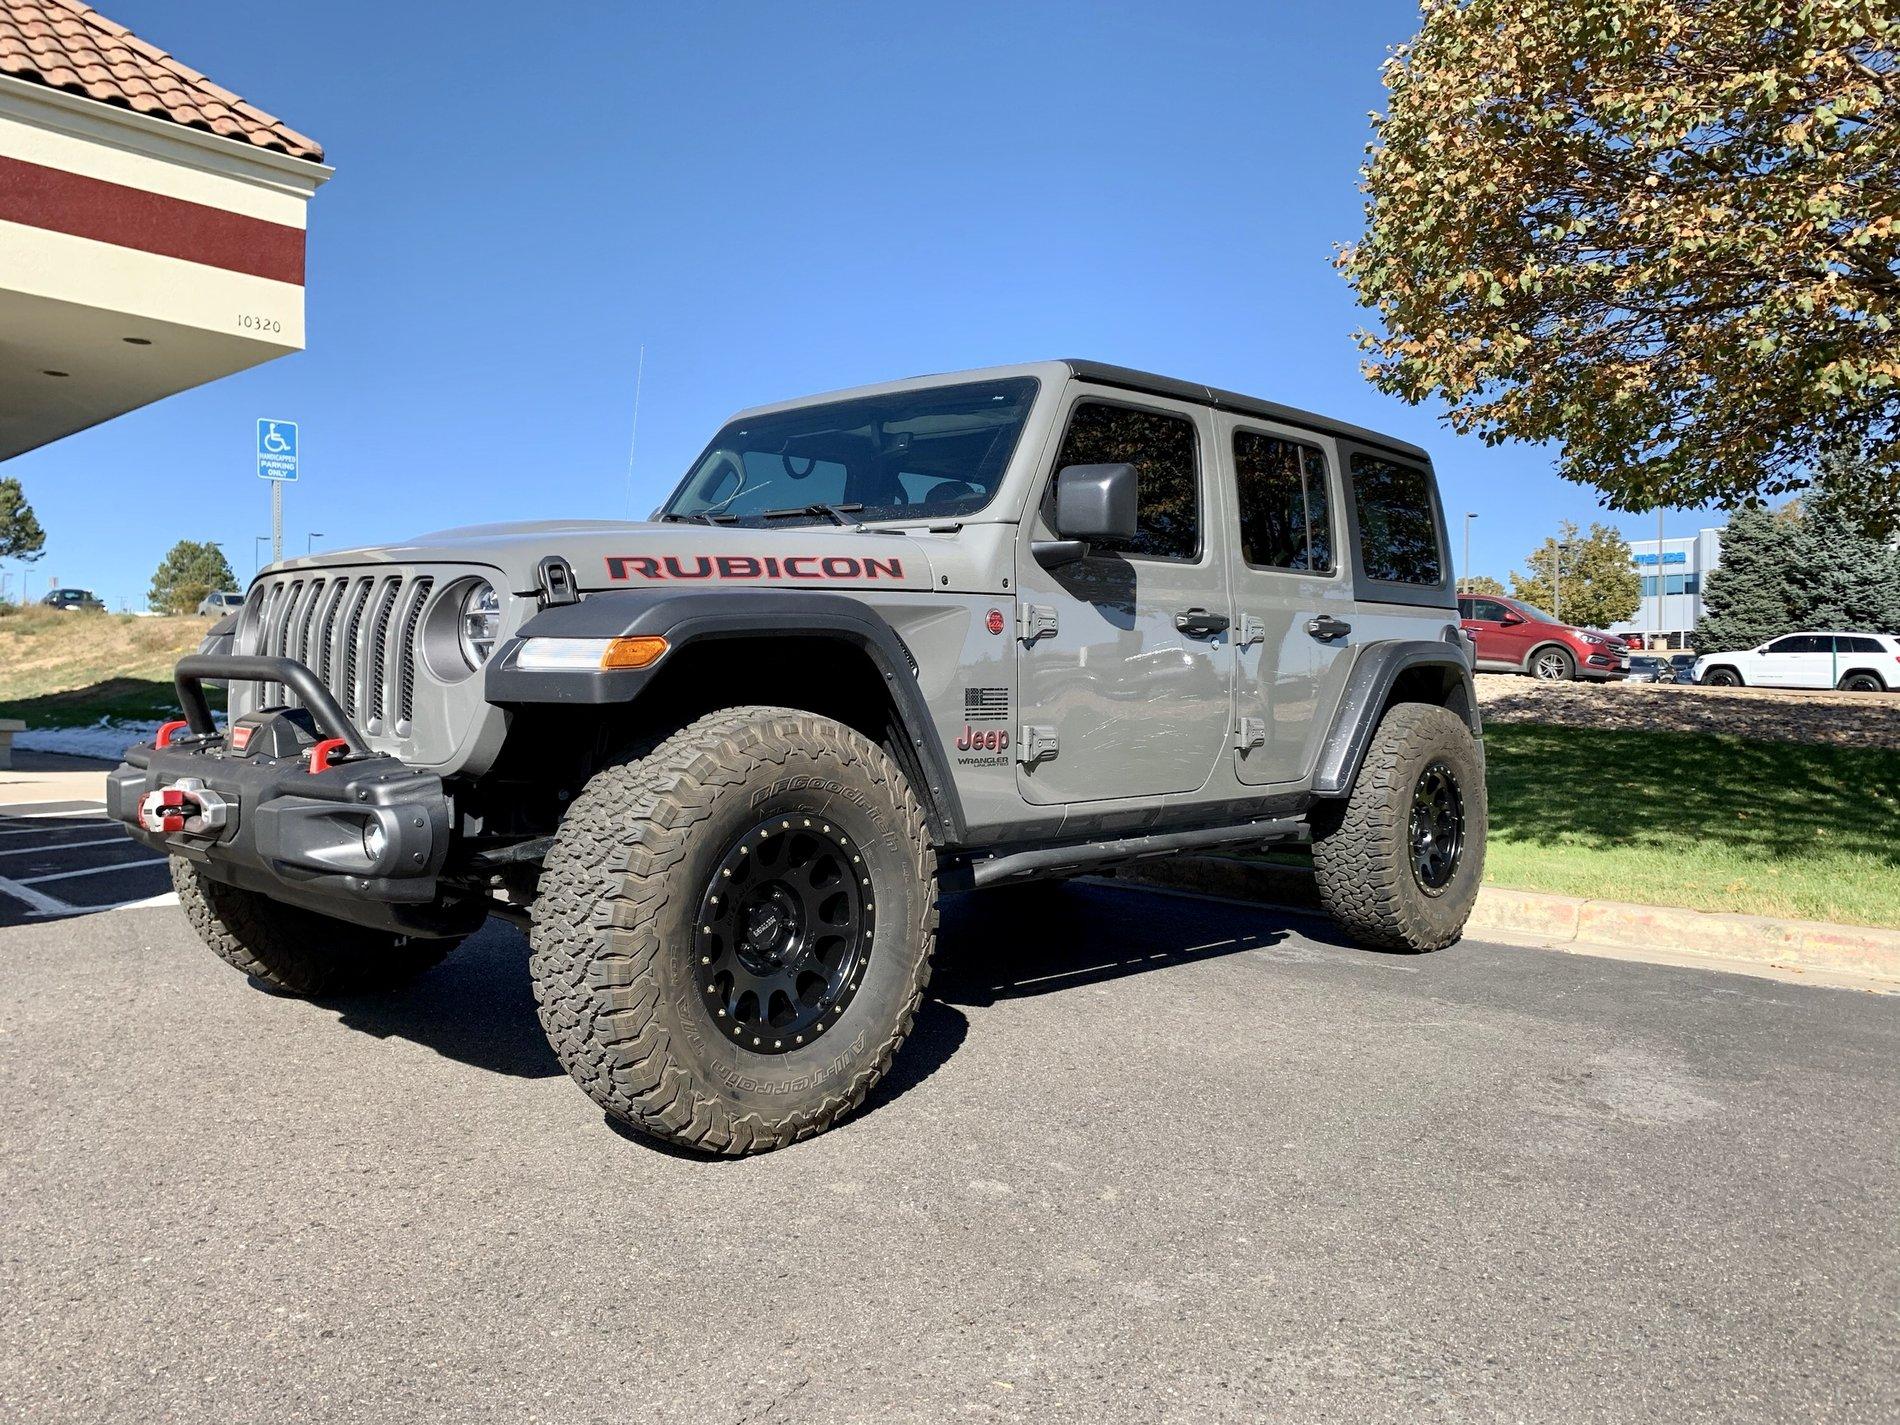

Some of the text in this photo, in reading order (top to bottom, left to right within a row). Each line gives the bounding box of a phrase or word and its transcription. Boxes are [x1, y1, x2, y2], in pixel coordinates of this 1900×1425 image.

[238, 314, 281, 333] 10320
[260, 460, 295, 471] PARKING
[267, 469, 288, 477] ONLY
[604, 556, 904, 580] RUBICON
[957, 725, 1009, 754] Jeep
[957, 757, 1009, 765] WRANGLER
[750, 774, 899, 854] BFGoodrich
[710, 1029, 867, 1096] All-Terrain
